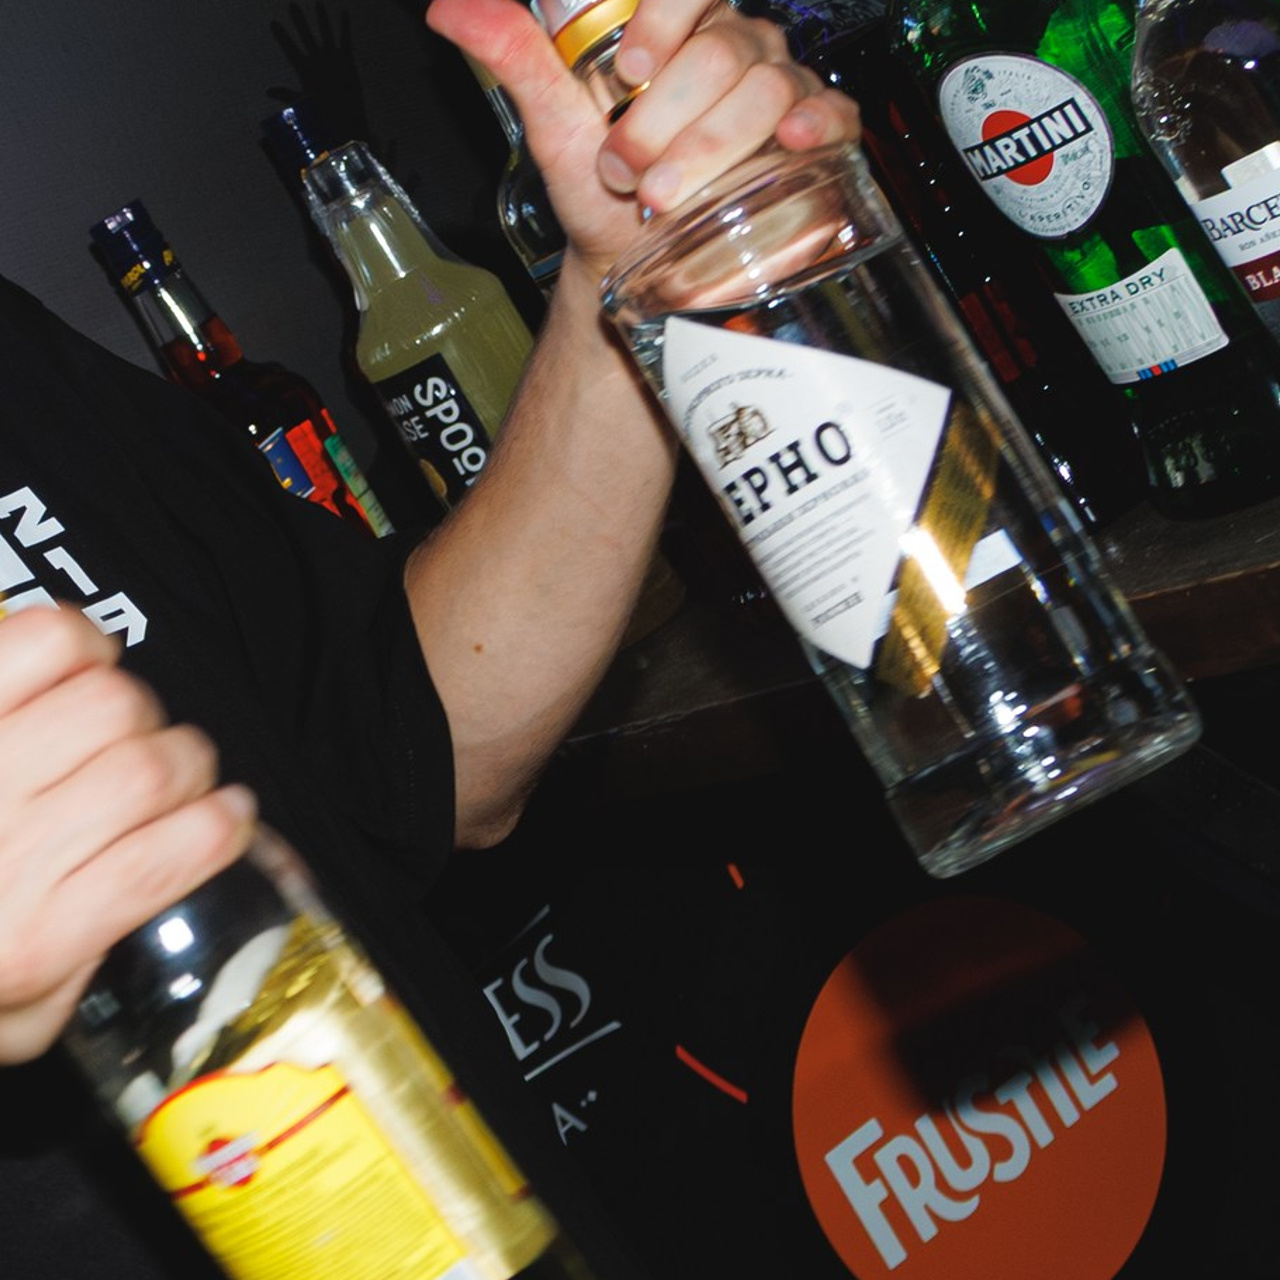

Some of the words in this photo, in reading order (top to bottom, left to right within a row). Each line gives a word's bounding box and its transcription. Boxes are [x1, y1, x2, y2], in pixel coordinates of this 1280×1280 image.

[966, 102, 1087, 178] MARTINI
[1069, 289, 1121, 315] EXTRA
[1125, 267, 1166, 296] DRY
[413, 376, 487, 487] SPOO
